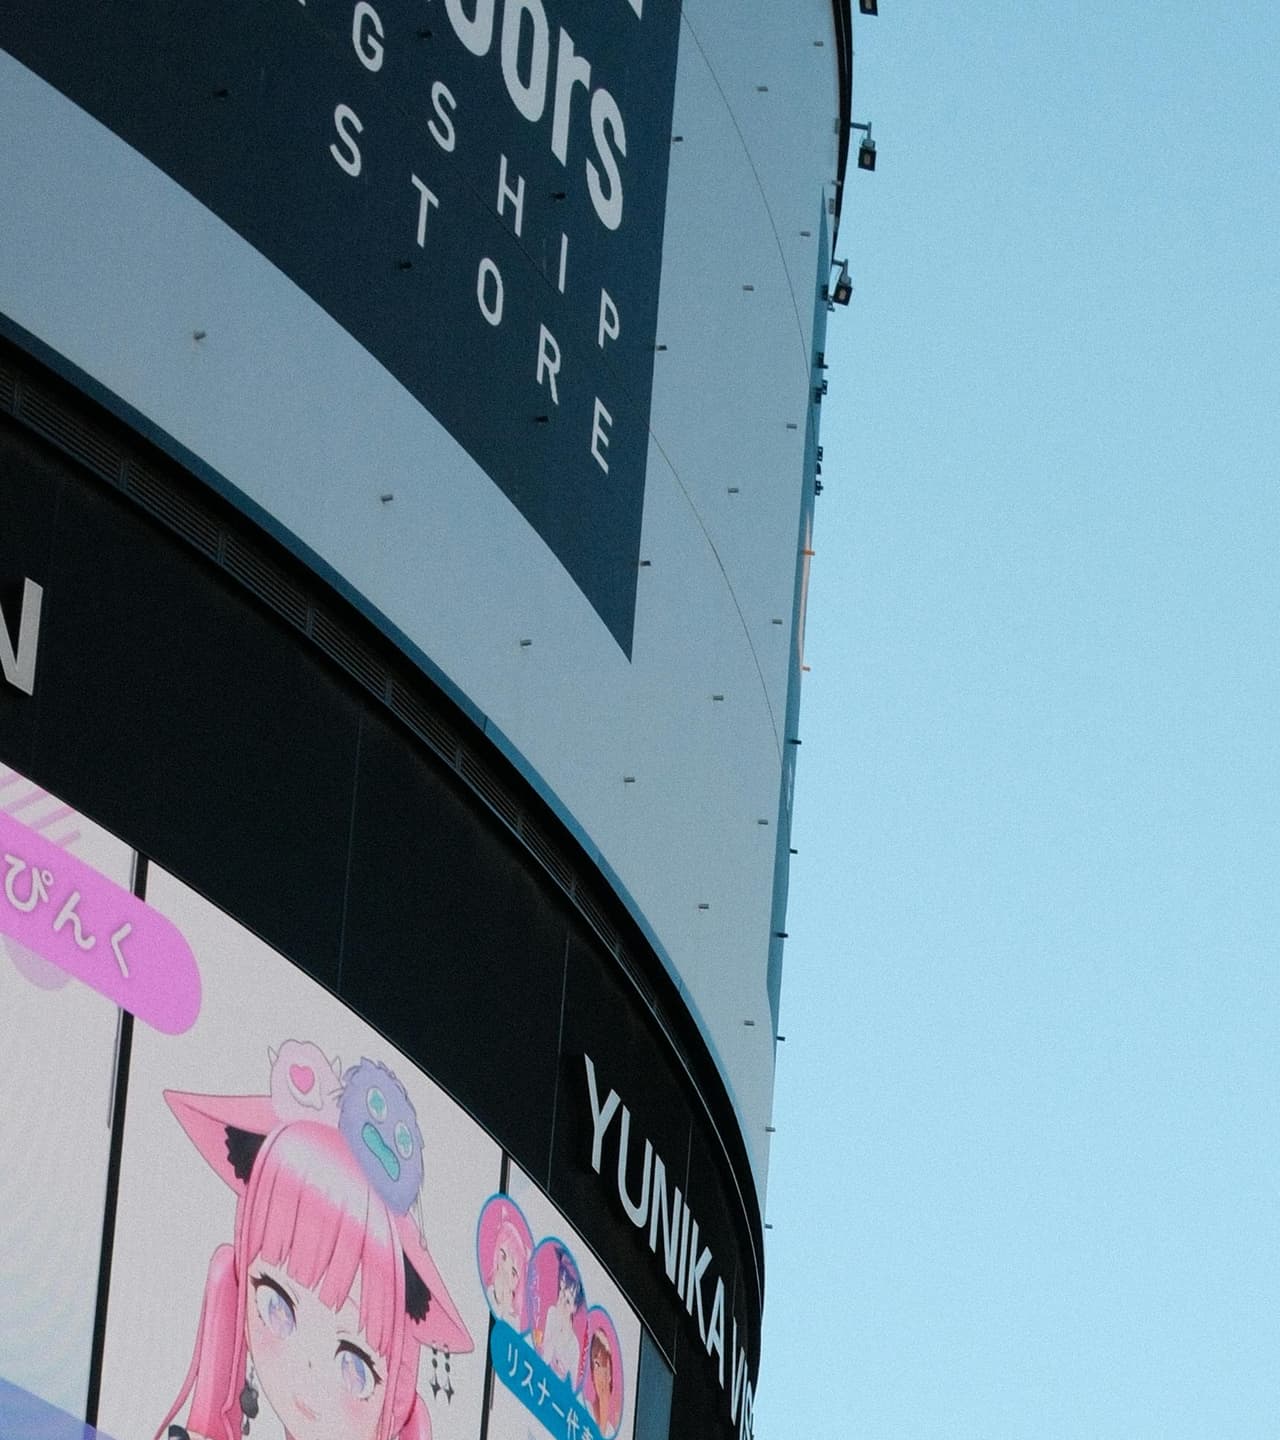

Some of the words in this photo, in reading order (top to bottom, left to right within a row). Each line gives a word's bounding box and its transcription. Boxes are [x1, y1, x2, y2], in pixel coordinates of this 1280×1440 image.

[329, 103, 614, 474] STORE
[3, 853, 132, 979] ぴんく
[584, 1053, 725, 1390] YUNIKA
